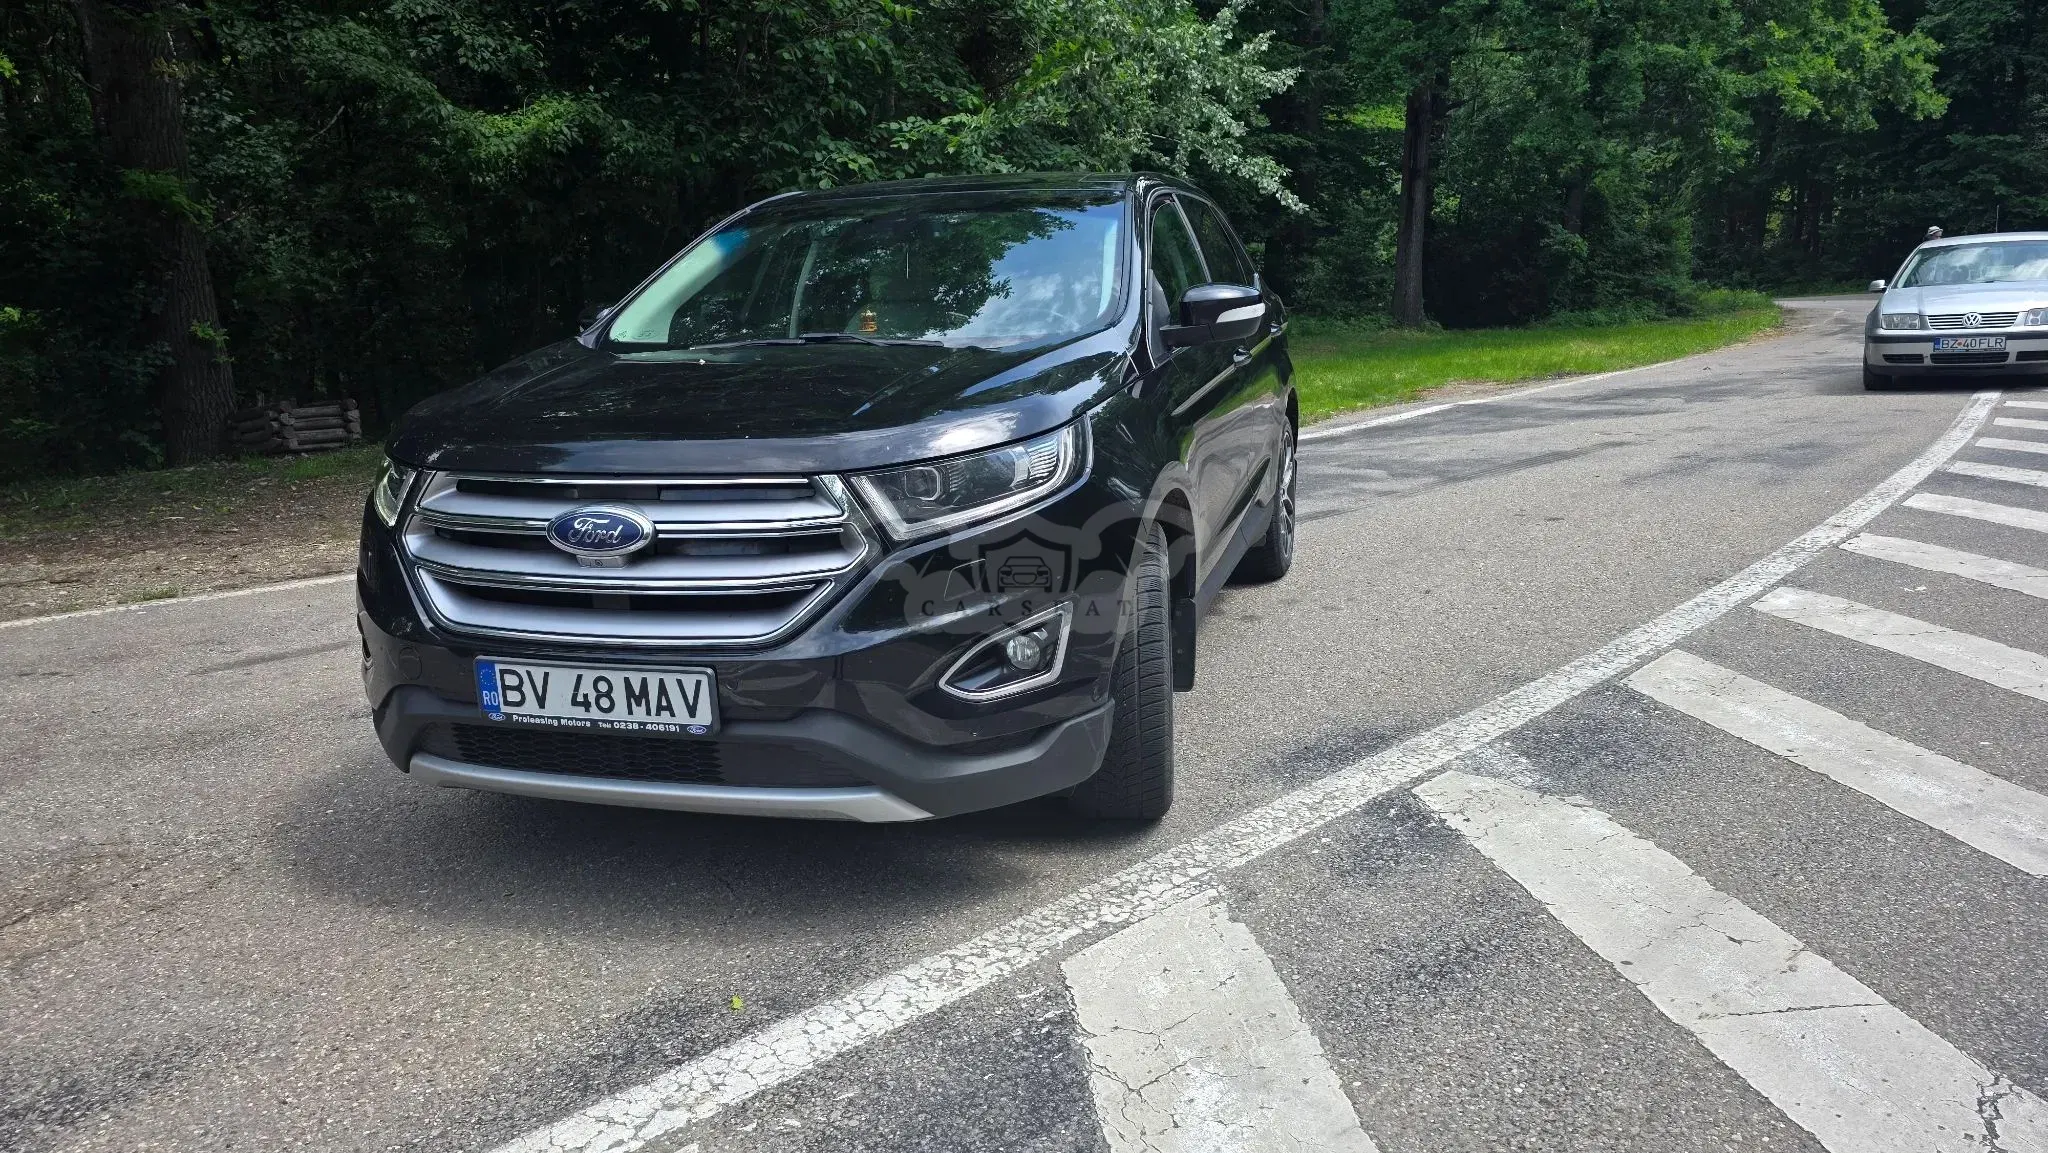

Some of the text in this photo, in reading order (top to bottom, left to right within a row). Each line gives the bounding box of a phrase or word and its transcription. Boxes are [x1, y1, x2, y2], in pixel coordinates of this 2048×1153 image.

[567, 517, 624, 544] Ford
[482, 690, 499, 706] RO
[499, 668, 703, 719] BV 48 MAV
[512, 714, 559, 727] Proleasing
[560, 718, 591, 728] Motors
